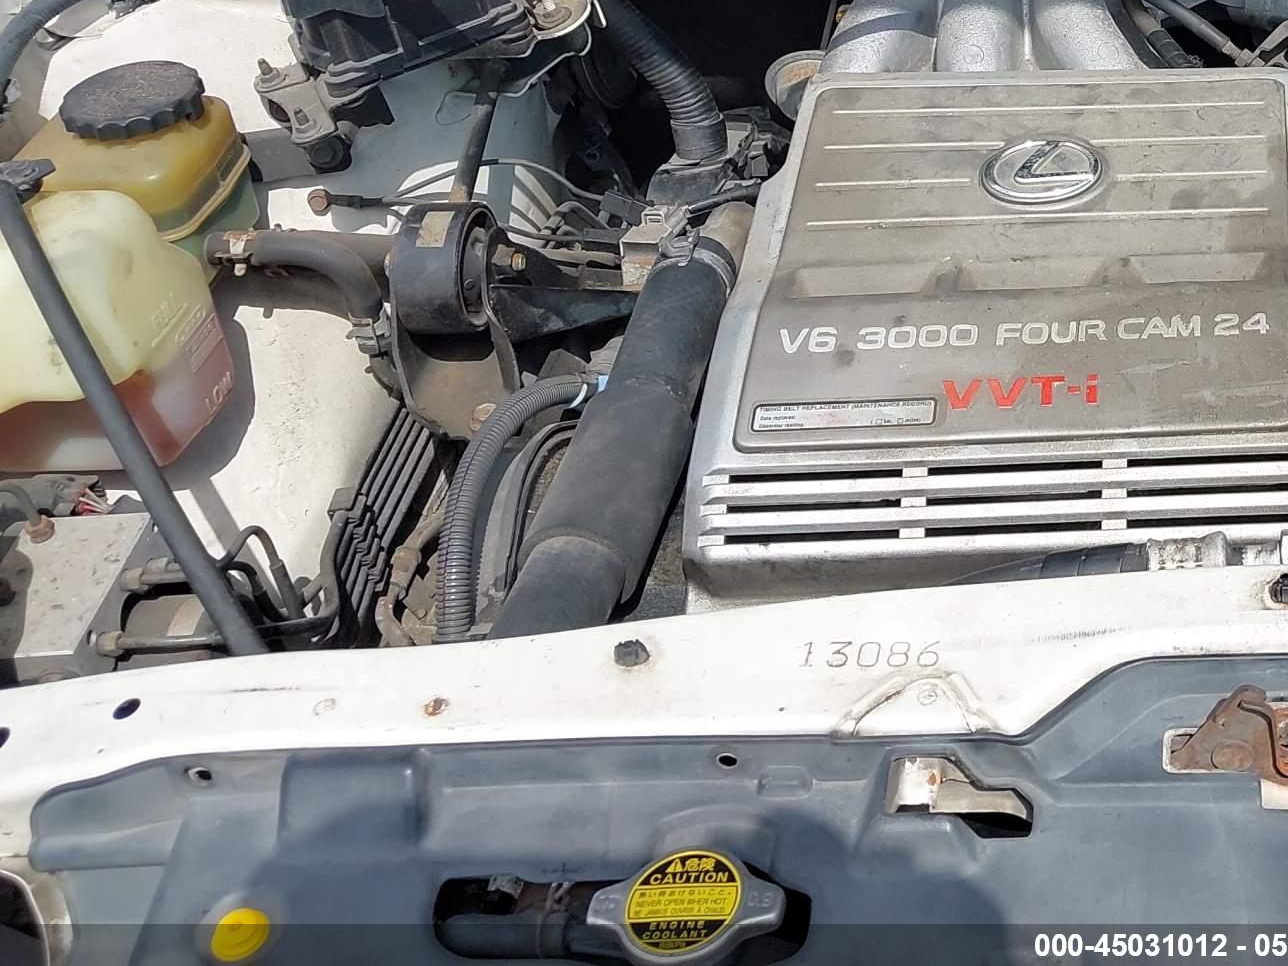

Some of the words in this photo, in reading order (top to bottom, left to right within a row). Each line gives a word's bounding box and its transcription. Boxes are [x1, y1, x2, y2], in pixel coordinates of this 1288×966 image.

[779, 326, 838, 354] V6
[856, 324, 979, 350] 3000
[995, 319, 1108, 346] FOUR
[1116, 314, 1202, 340] CAM
[1213, 312, 1270, 336] 24
[942, 373, 1099, 411] VVT-i
[801, 404, 850, 412] REPLACEMENT
[799, 640, 940, 668] 13086
[684, 857, 717, 872] 危険
[649, 872, 729, 885] CAUTION
[635, 900, 662, 908] NEVER
[663, 898, 686, 907] OPEN
[687, 897, 709, 905] WHEN
[709, 897, 727, 905] HOT
[649, 920, 706, 931] ENGINE
[642, 929, 708, 940] COOLANT
